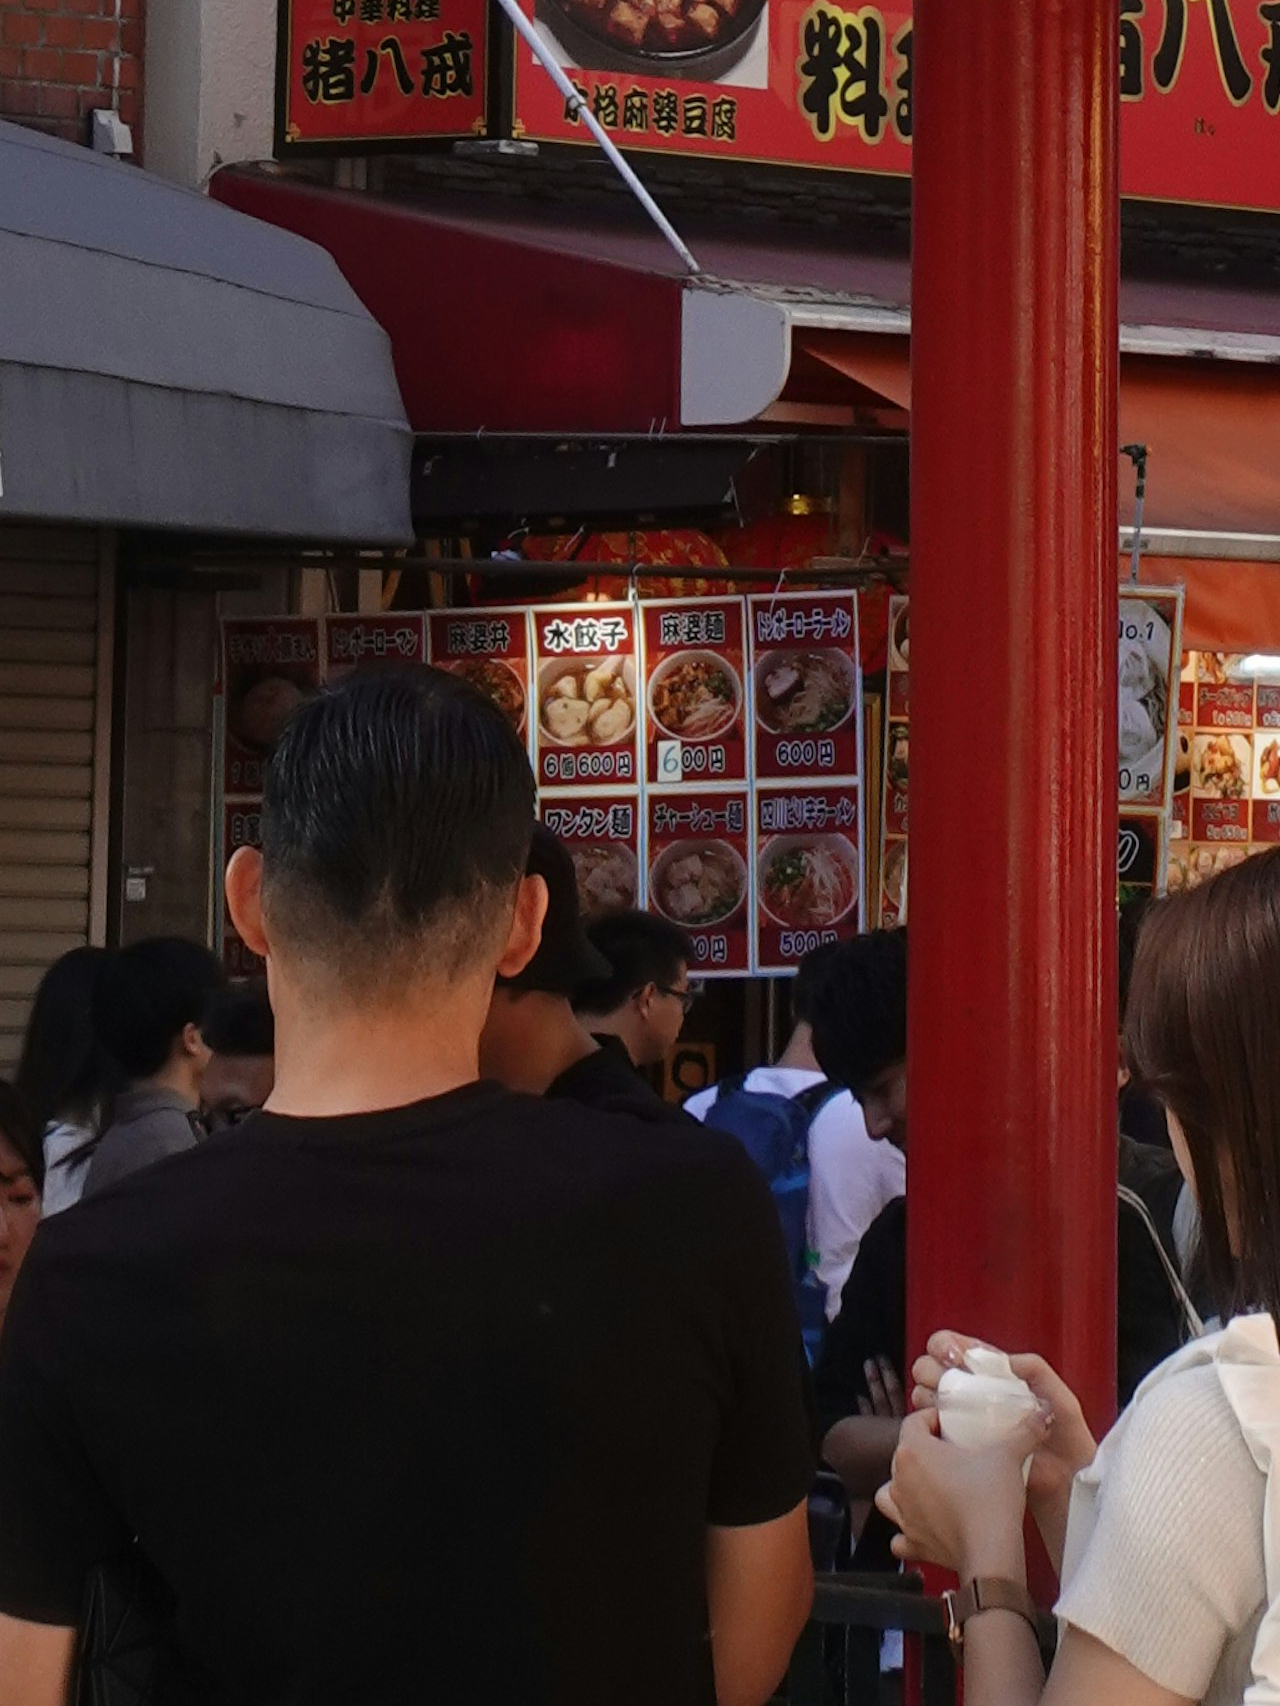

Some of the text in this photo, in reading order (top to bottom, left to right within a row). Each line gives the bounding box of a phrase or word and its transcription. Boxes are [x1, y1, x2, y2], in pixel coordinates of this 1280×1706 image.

[544, 616, 628, 652] 水餃子
[776, 740, 835, 767] 600円
